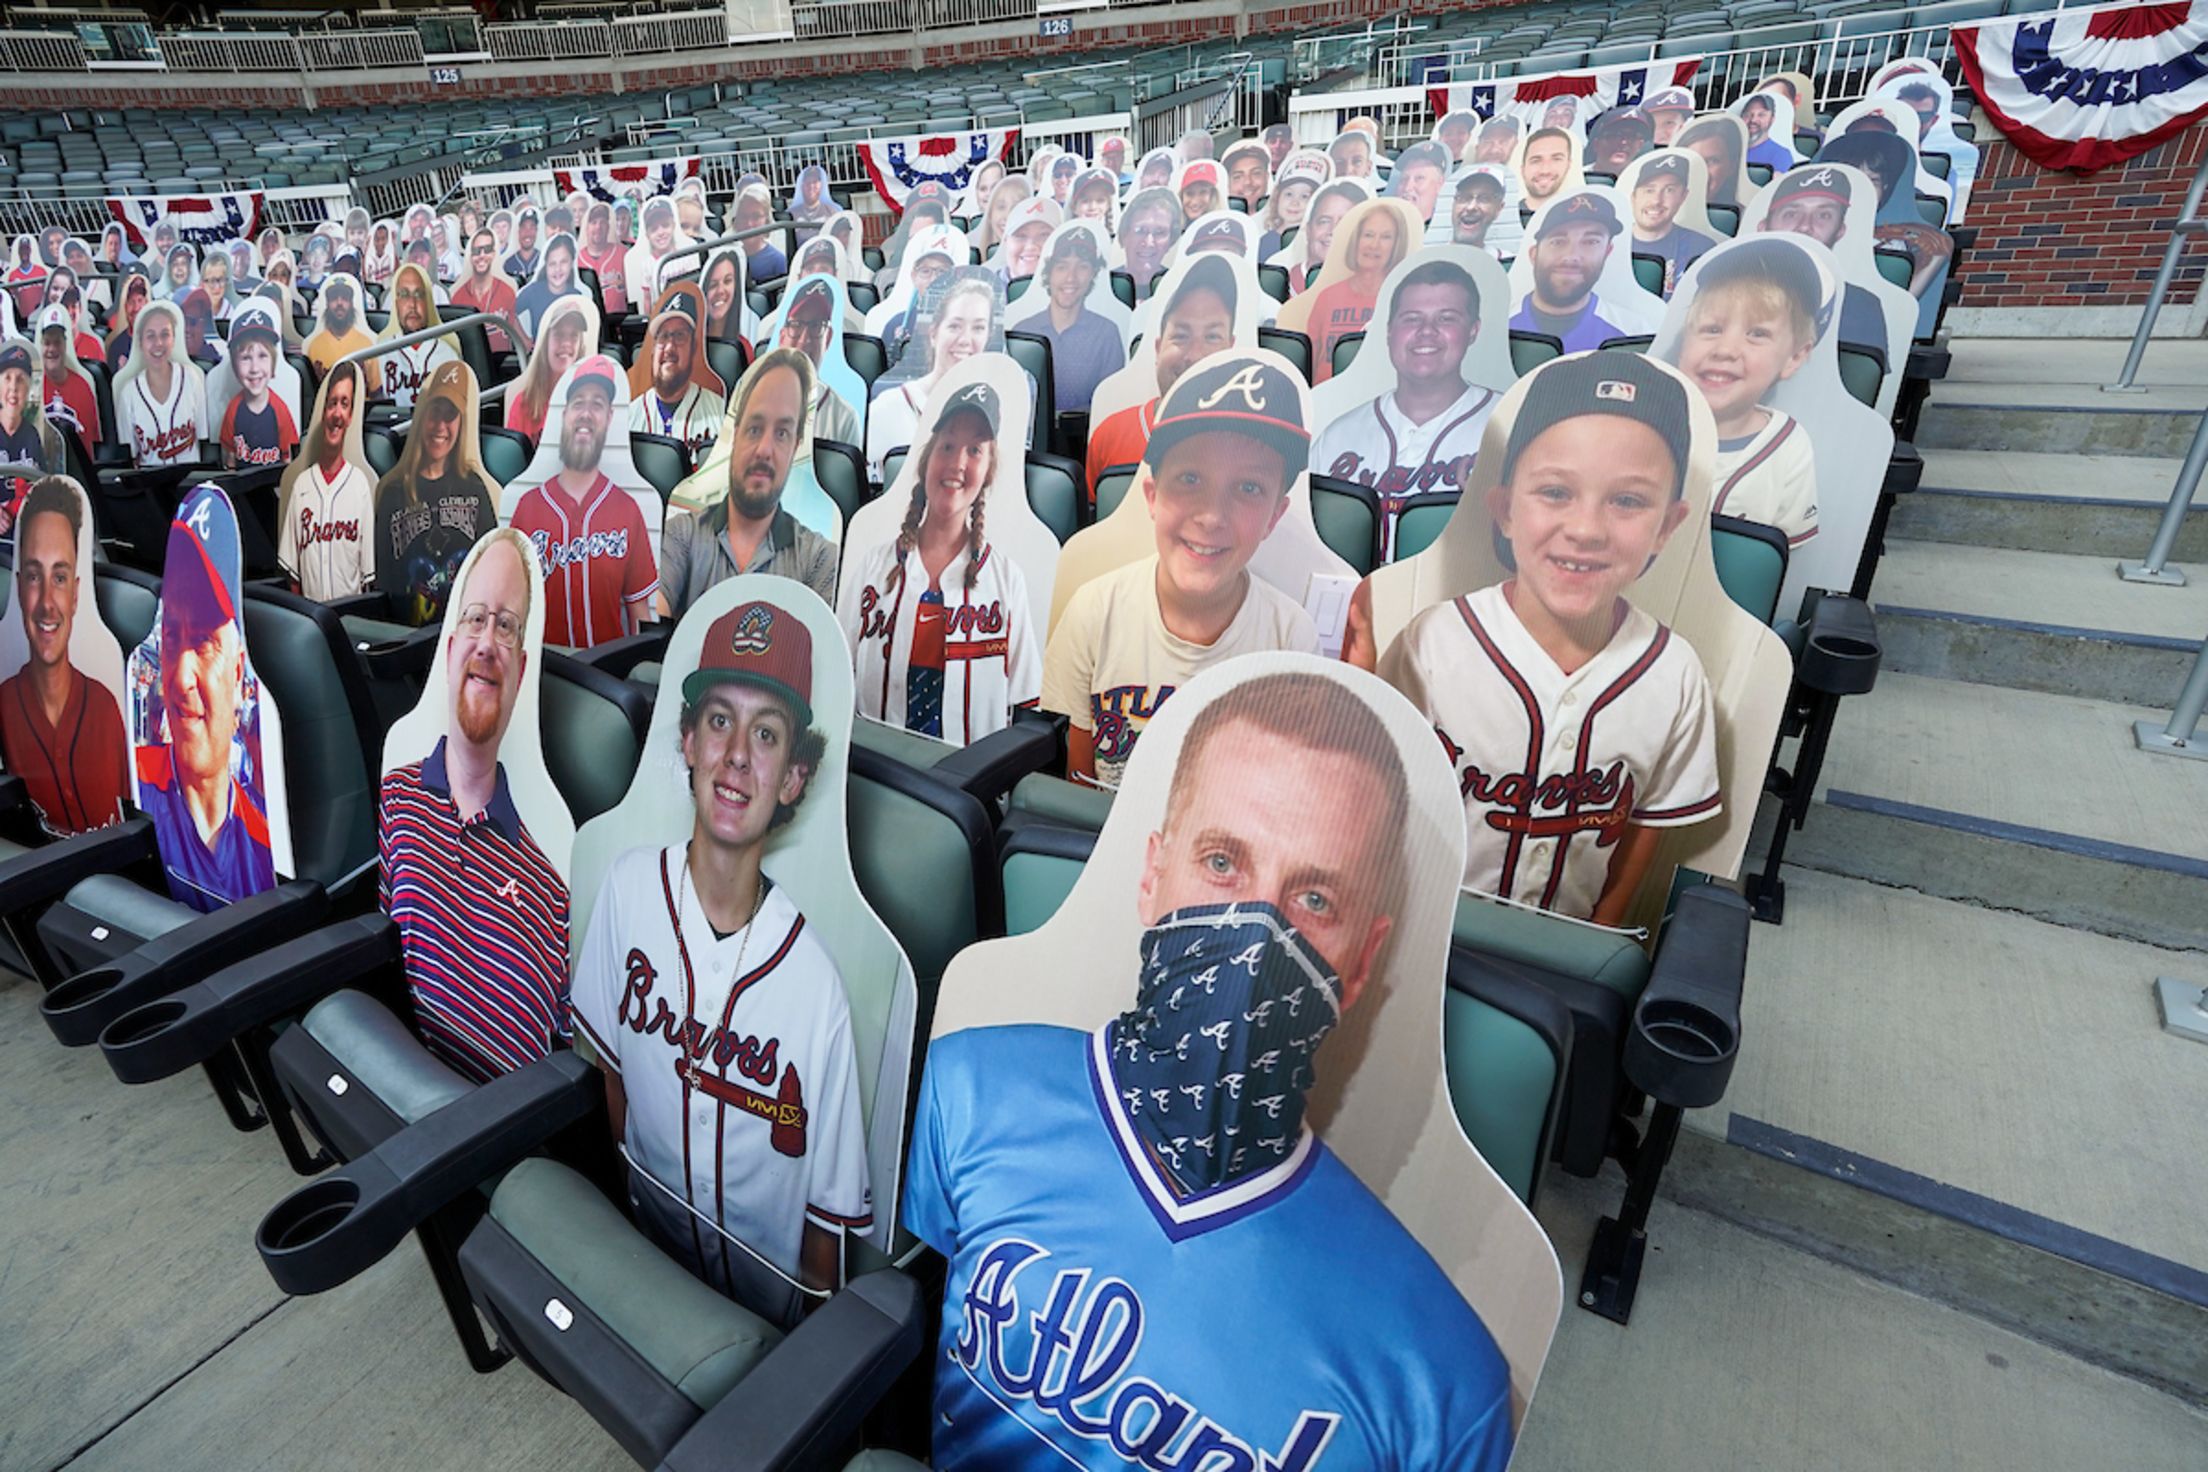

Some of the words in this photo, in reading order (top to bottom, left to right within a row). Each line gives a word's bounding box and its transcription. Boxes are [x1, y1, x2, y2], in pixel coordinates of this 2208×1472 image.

[1044, 19, 1069, 35] 126
[434, 69, 459, 83] 125
[1657, 91, 1678, 105] A
[1656, 155, 1676, 169] A
[1800, 168, 1832, 187] A
[1026, 201, 1044, 215] A
[1067, 227, 1086, 241] A
[1209, 220, 1231, 235] A
[931, 237, 947, 250] A
[806, 282, 825, 296] A
[241, 310, 264, 327] A
[442, 367, 459, 384] A
[961, 382, 988, 402] A
[1198, 364, 1265, 410] A
[186, 497, 212, 541] A
[300, 507, 358, 555] Braves
[1435, 725, 1624, 809] raves
[497, 878, 522, 908] A
[1229, 942, 1266, 976] A
[1191, 965, 1220, 994] A
[619, 948, 779, 1086] Braves
[1243, 1000, 1274, 1028] A
[1200, 1021, 1233, 1051] A
[1215, 1073, 1245, 1100] A
[1252, 1094, 1286, 1118] A
